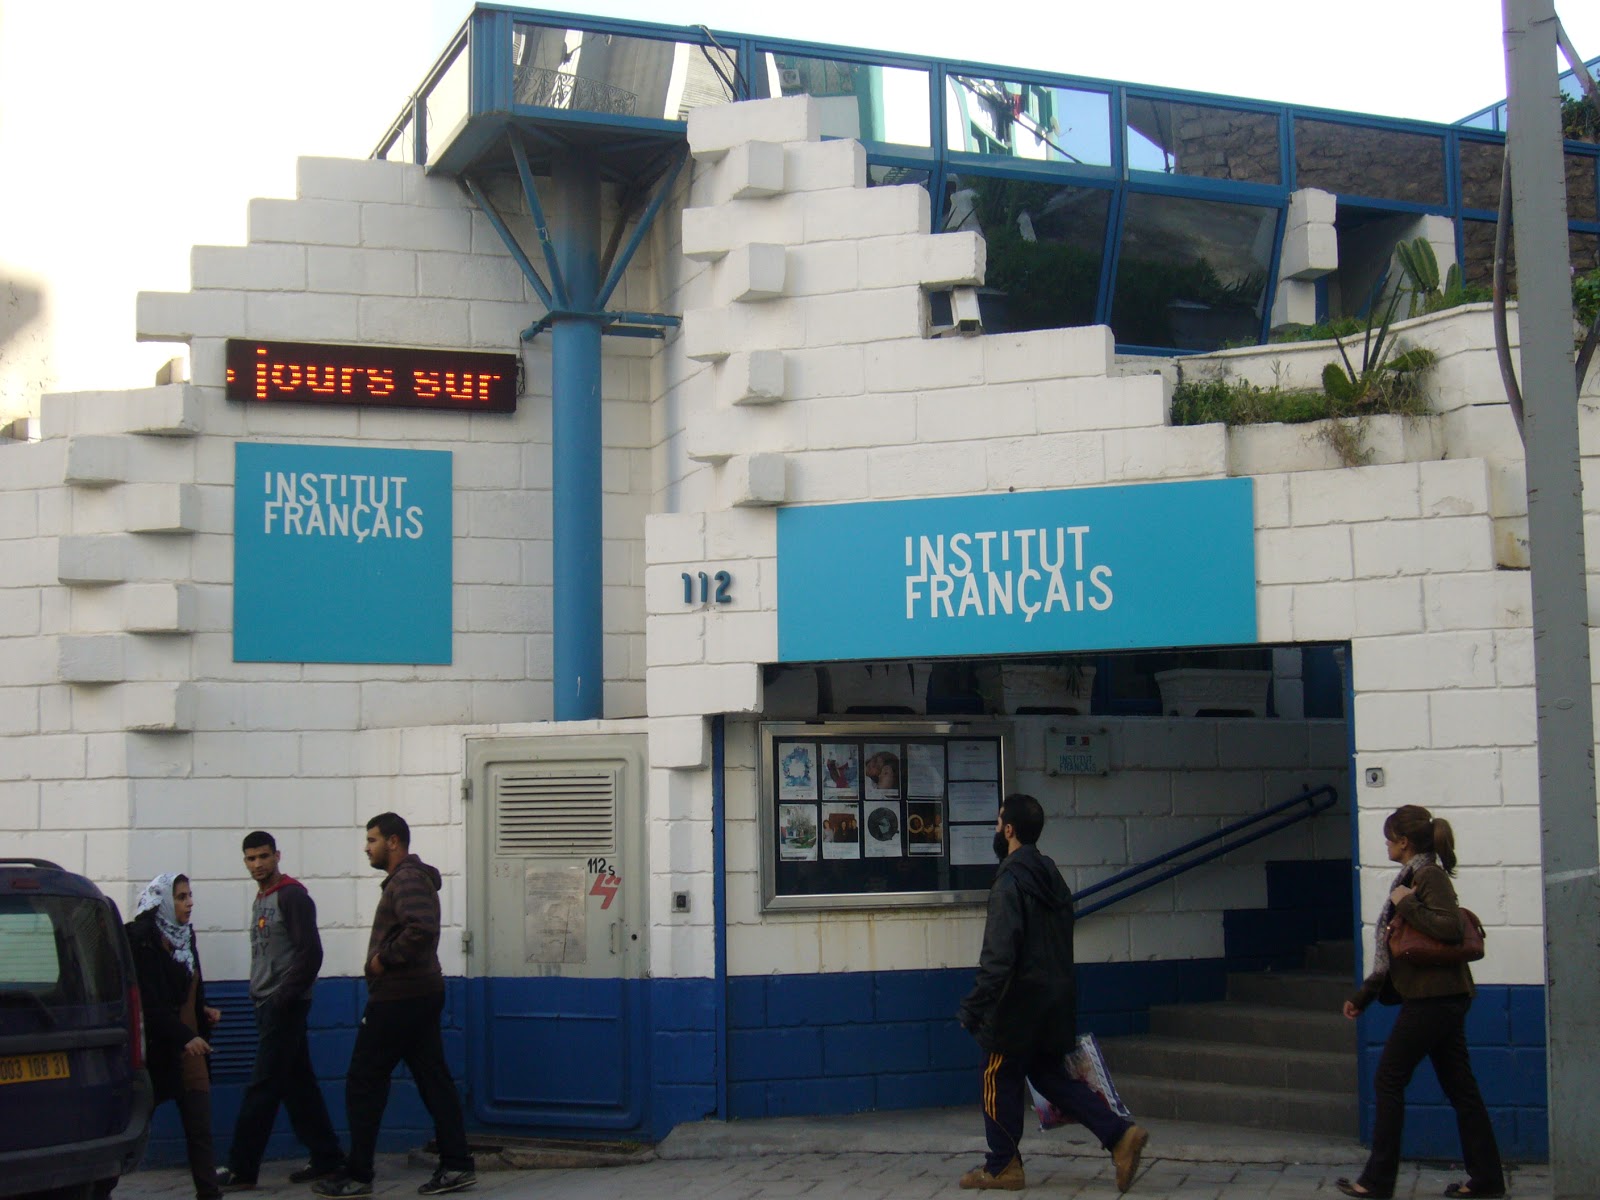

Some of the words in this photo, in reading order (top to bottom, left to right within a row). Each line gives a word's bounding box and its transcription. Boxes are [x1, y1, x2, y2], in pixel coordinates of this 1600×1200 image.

[257, 348, 395, 398] jours
[413, 371, 500, 400] sur
[264, 471, 408, 508] INSTITUT
[264, 501, 424, 543] FRANÇAIS
[905, 525, 1090, 577] INSTITUT
[681, 570, 732, 603] 112
[905, 565, 1114, 622] FRANÇAIS
